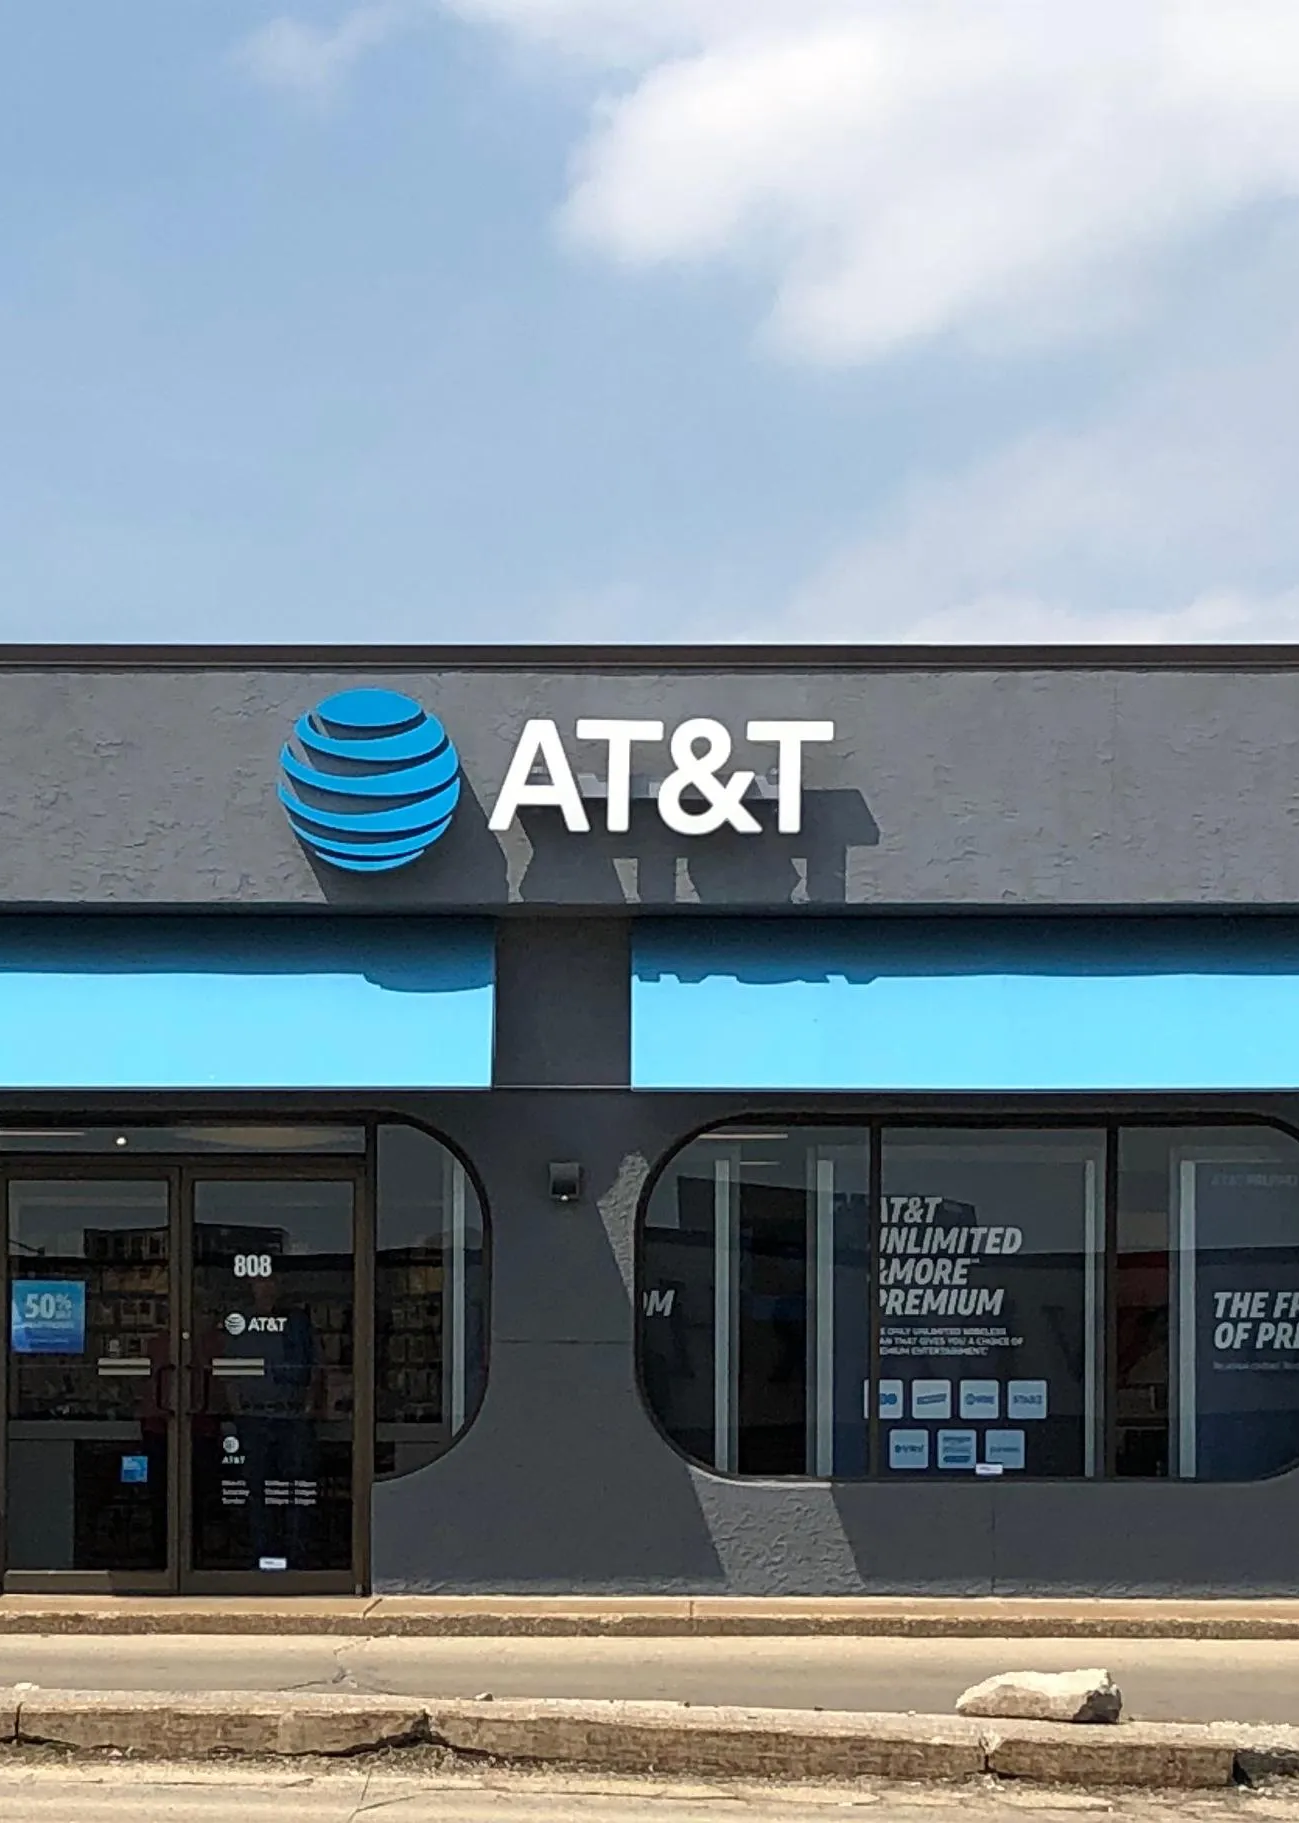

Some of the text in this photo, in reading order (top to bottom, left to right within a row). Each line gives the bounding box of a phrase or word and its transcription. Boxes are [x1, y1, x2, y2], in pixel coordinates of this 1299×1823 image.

[488, 717, 834, 835] AT&T
[233, 1254, 272, 1277] 808
[1214, 1291, 1269, 1318] THE
[248, 1316, 288, 1332] AT&T
[1214, 1322, 1252, 1349] OF
